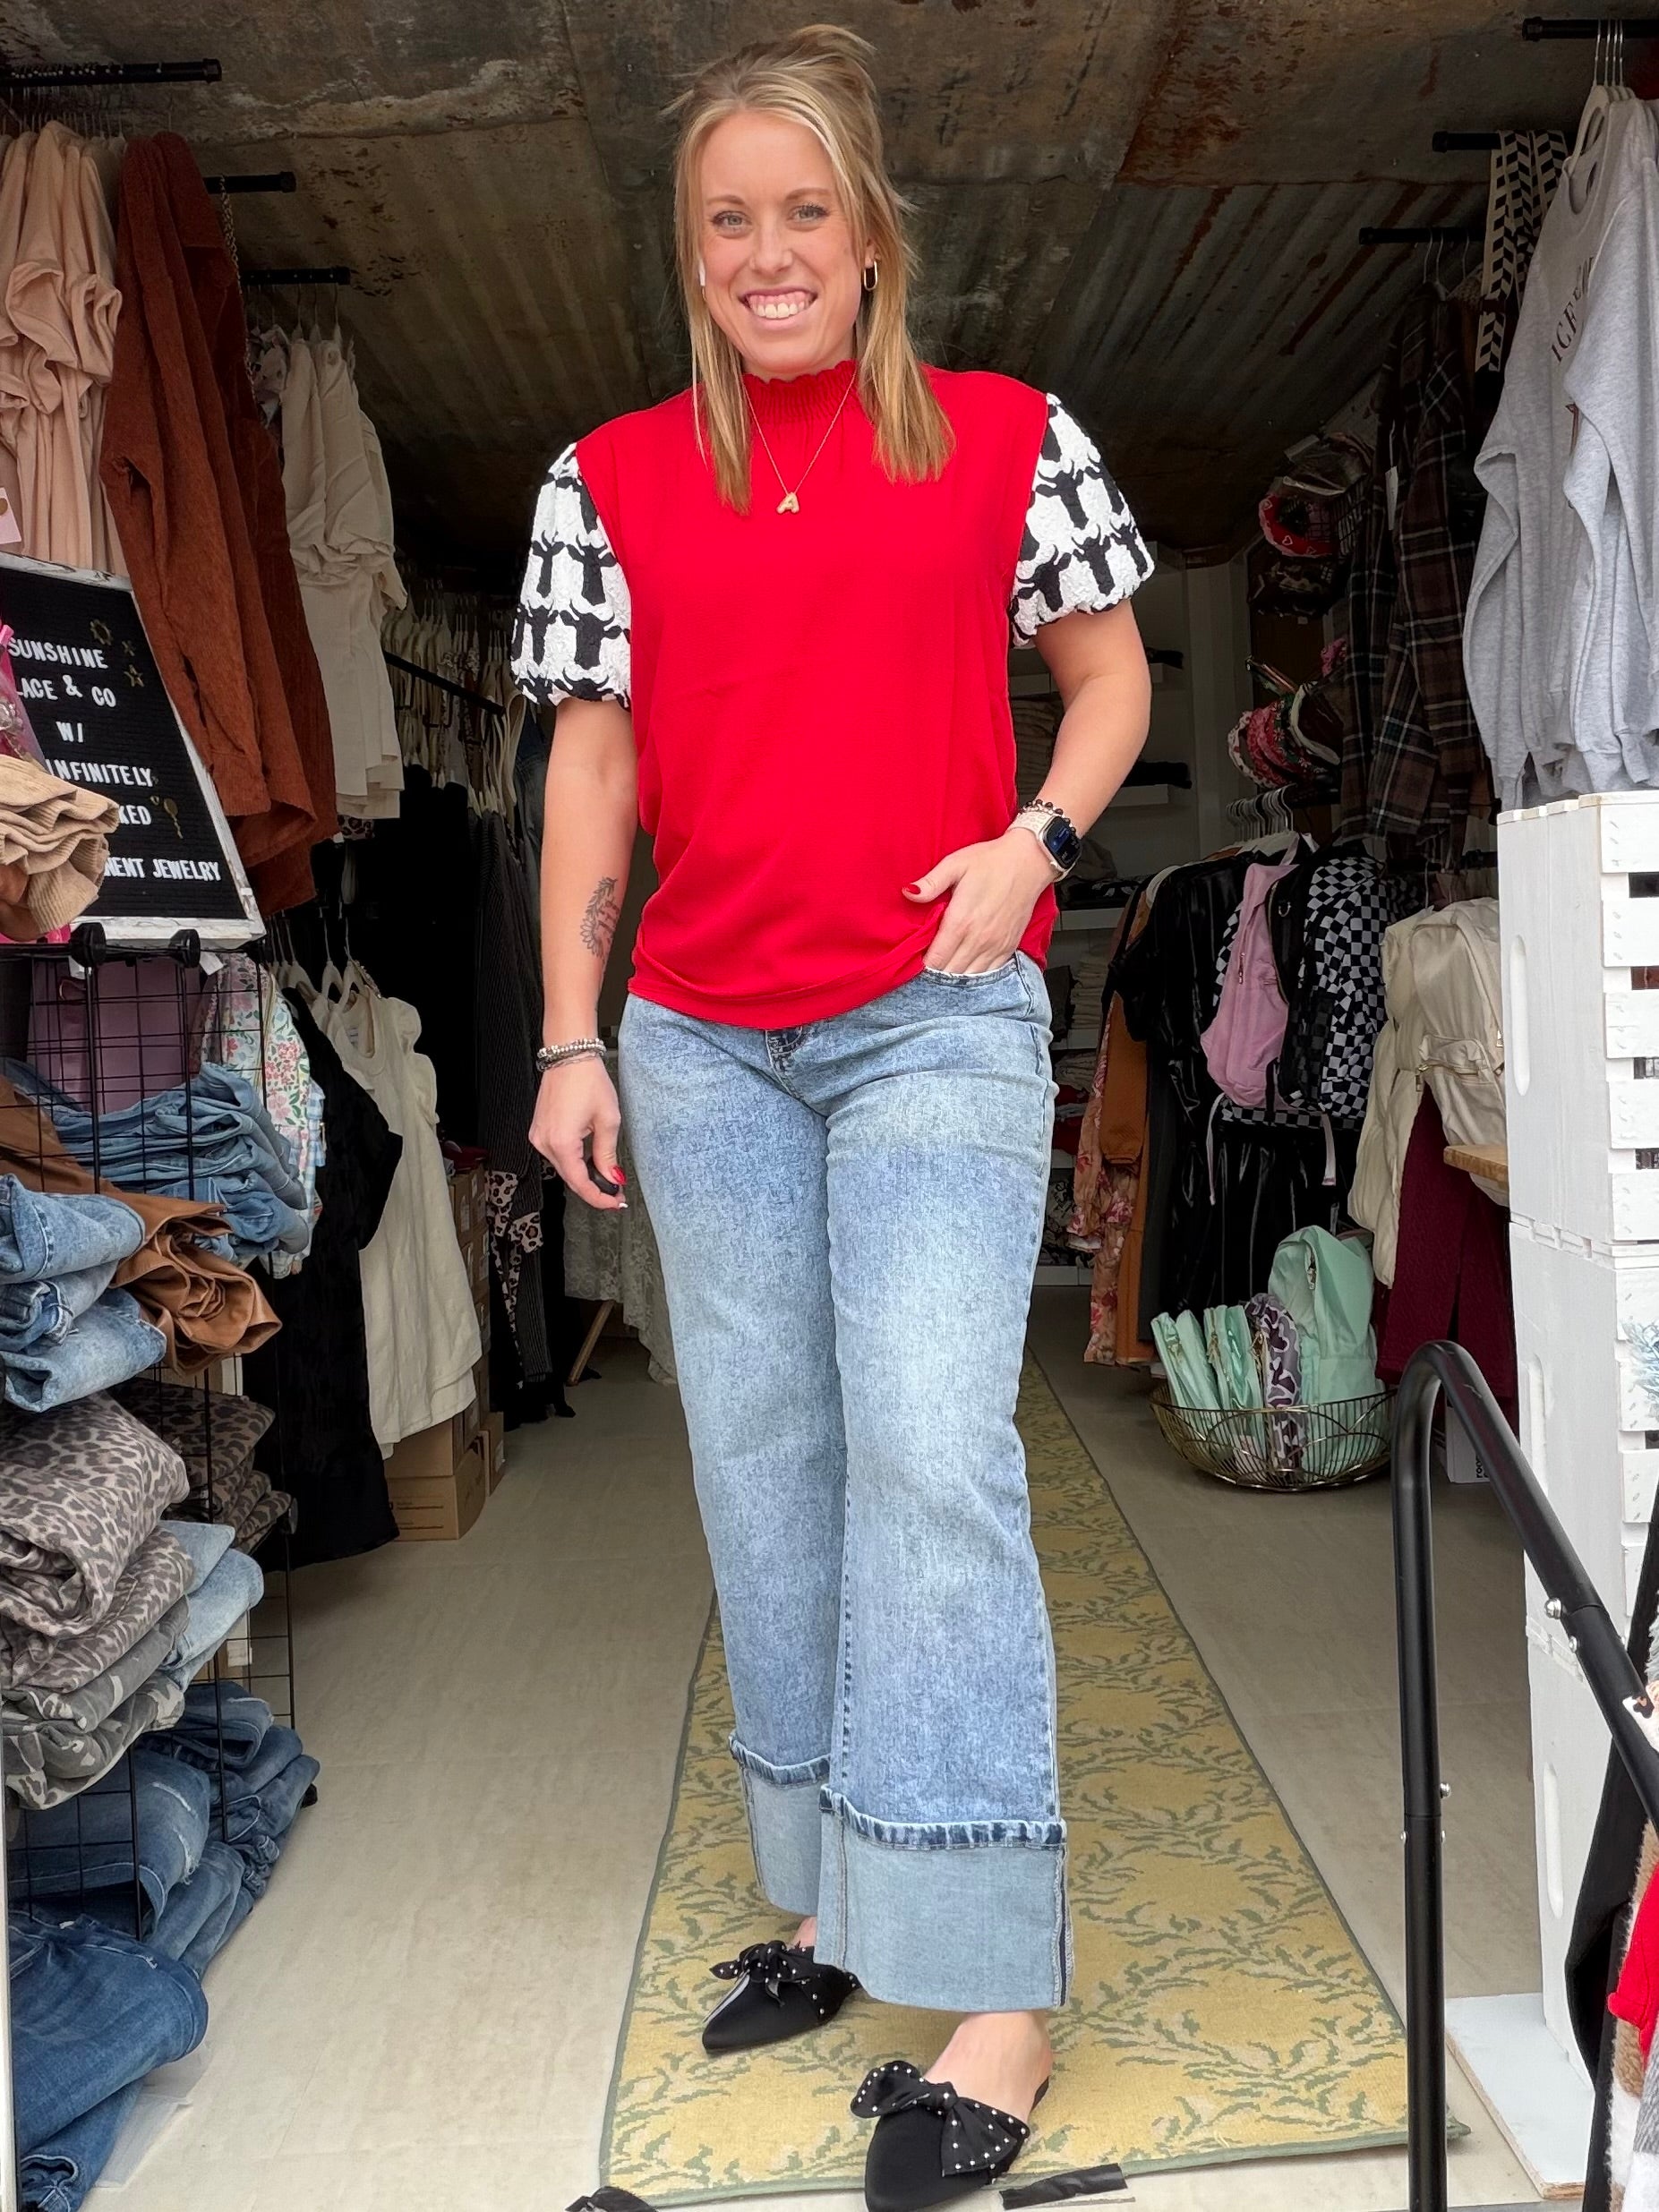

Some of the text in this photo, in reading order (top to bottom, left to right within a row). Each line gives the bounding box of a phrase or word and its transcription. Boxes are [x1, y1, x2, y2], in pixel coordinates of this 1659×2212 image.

[8, 636, 108, 670] SUNSHINE
[17, 674, 116, 708] ACE & CO
[46, 759, 153, 788] INFINITELY
[152, 858, 222, 882] JEWELRY
